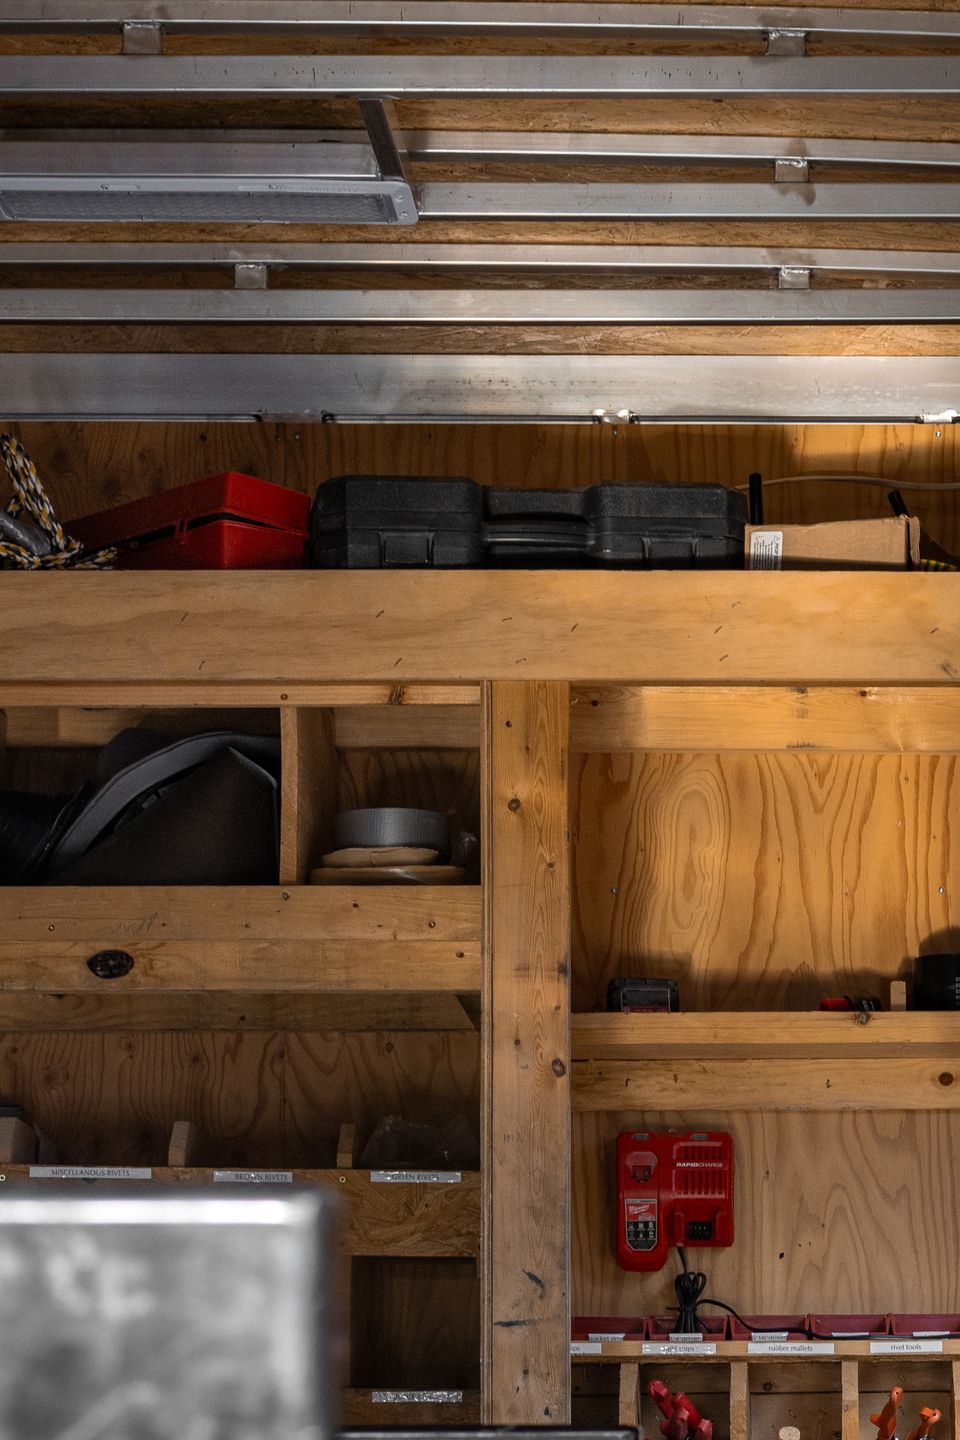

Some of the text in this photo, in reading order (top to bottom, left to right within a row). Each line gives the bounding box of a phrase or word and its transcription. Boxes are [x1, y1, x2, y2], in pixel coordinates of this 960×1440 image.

[51, 1168, 130, 1177] MISCELLANOUS RIVETS
[768, 1344, 814, 1352] rubber mallets
[890, 1343, 922, 1351] rivet tools
